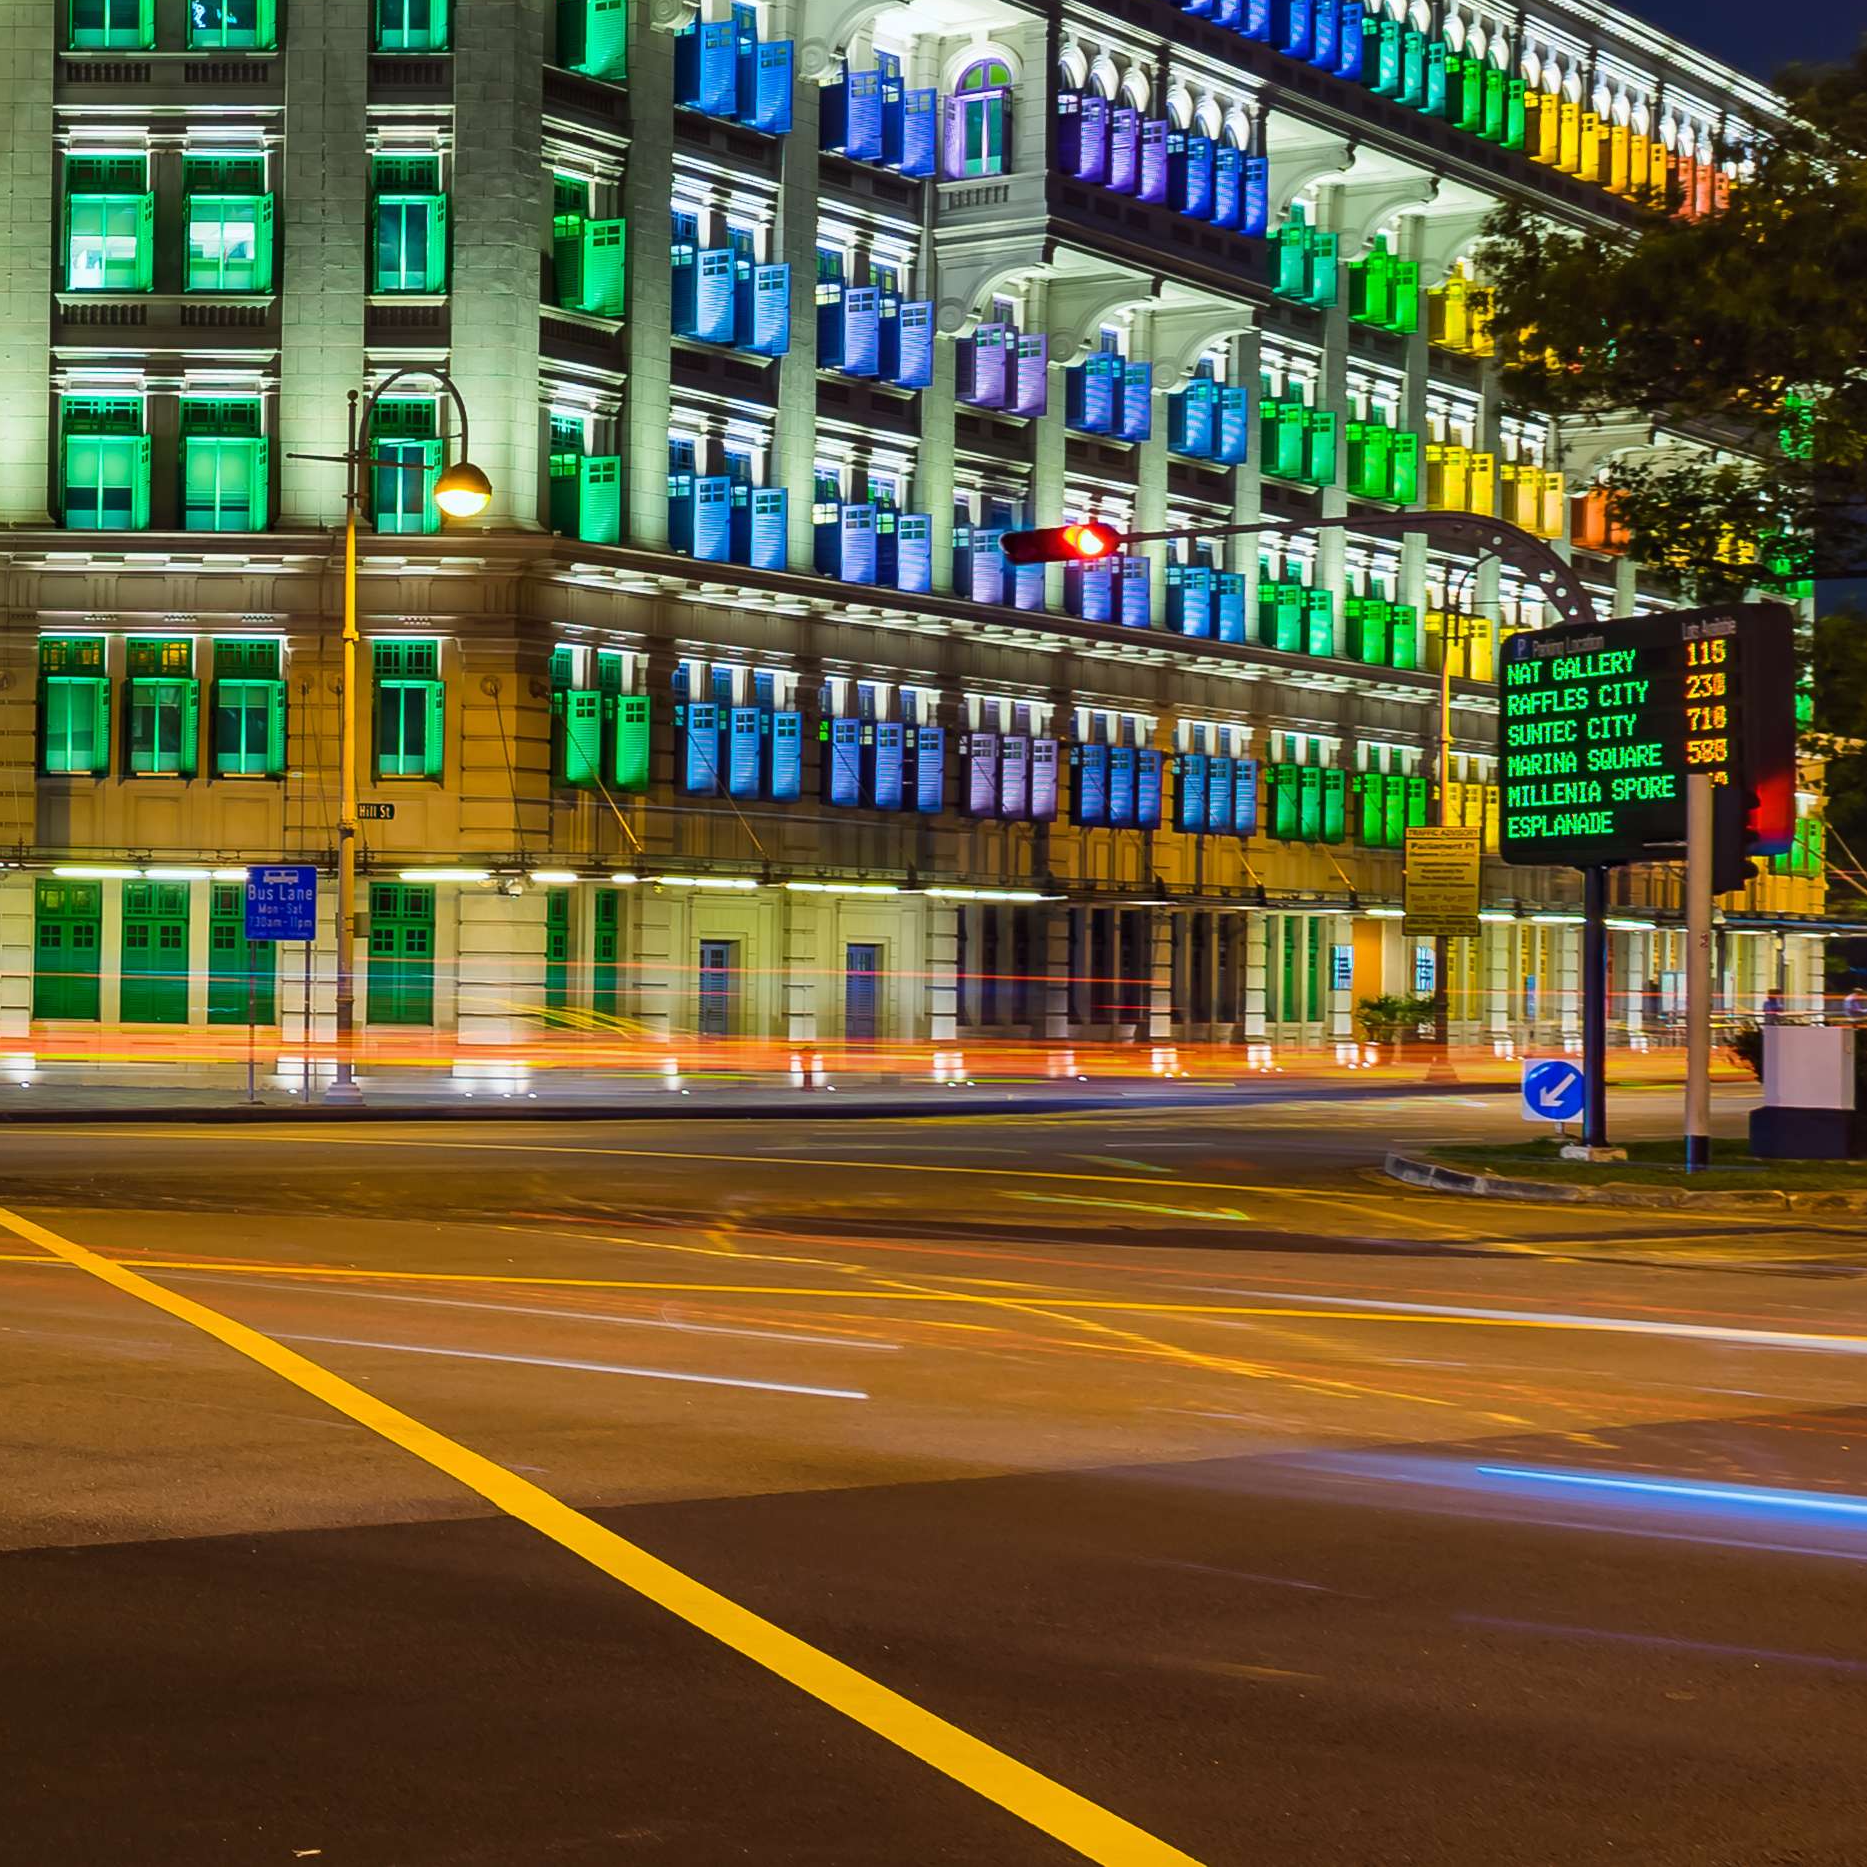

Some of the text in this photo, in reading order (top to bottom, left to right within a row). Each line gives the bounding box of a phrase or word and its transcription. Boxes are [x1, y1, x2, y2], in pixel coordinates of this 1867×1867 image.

[1532, 633, 1605, 658] Parking Location
[1506, 649, 1636, 686] NAT GALLERY
[1506, 680, 1649, 717] RAFFLES CITY
[1506, 714, 1637, 747] SUNTEC CITY
[1506, 743, 1663, 778] MARINA SQUARE
[1506, 781, 1602, 808] MILLENIA
[1611, 774, 1676, 802] SPORE
[359, 805, 392, 818] Hill St
[1506, 811, 1614, 839] ESPLANADE
[248, 884, 313, 901] Bus Lane
